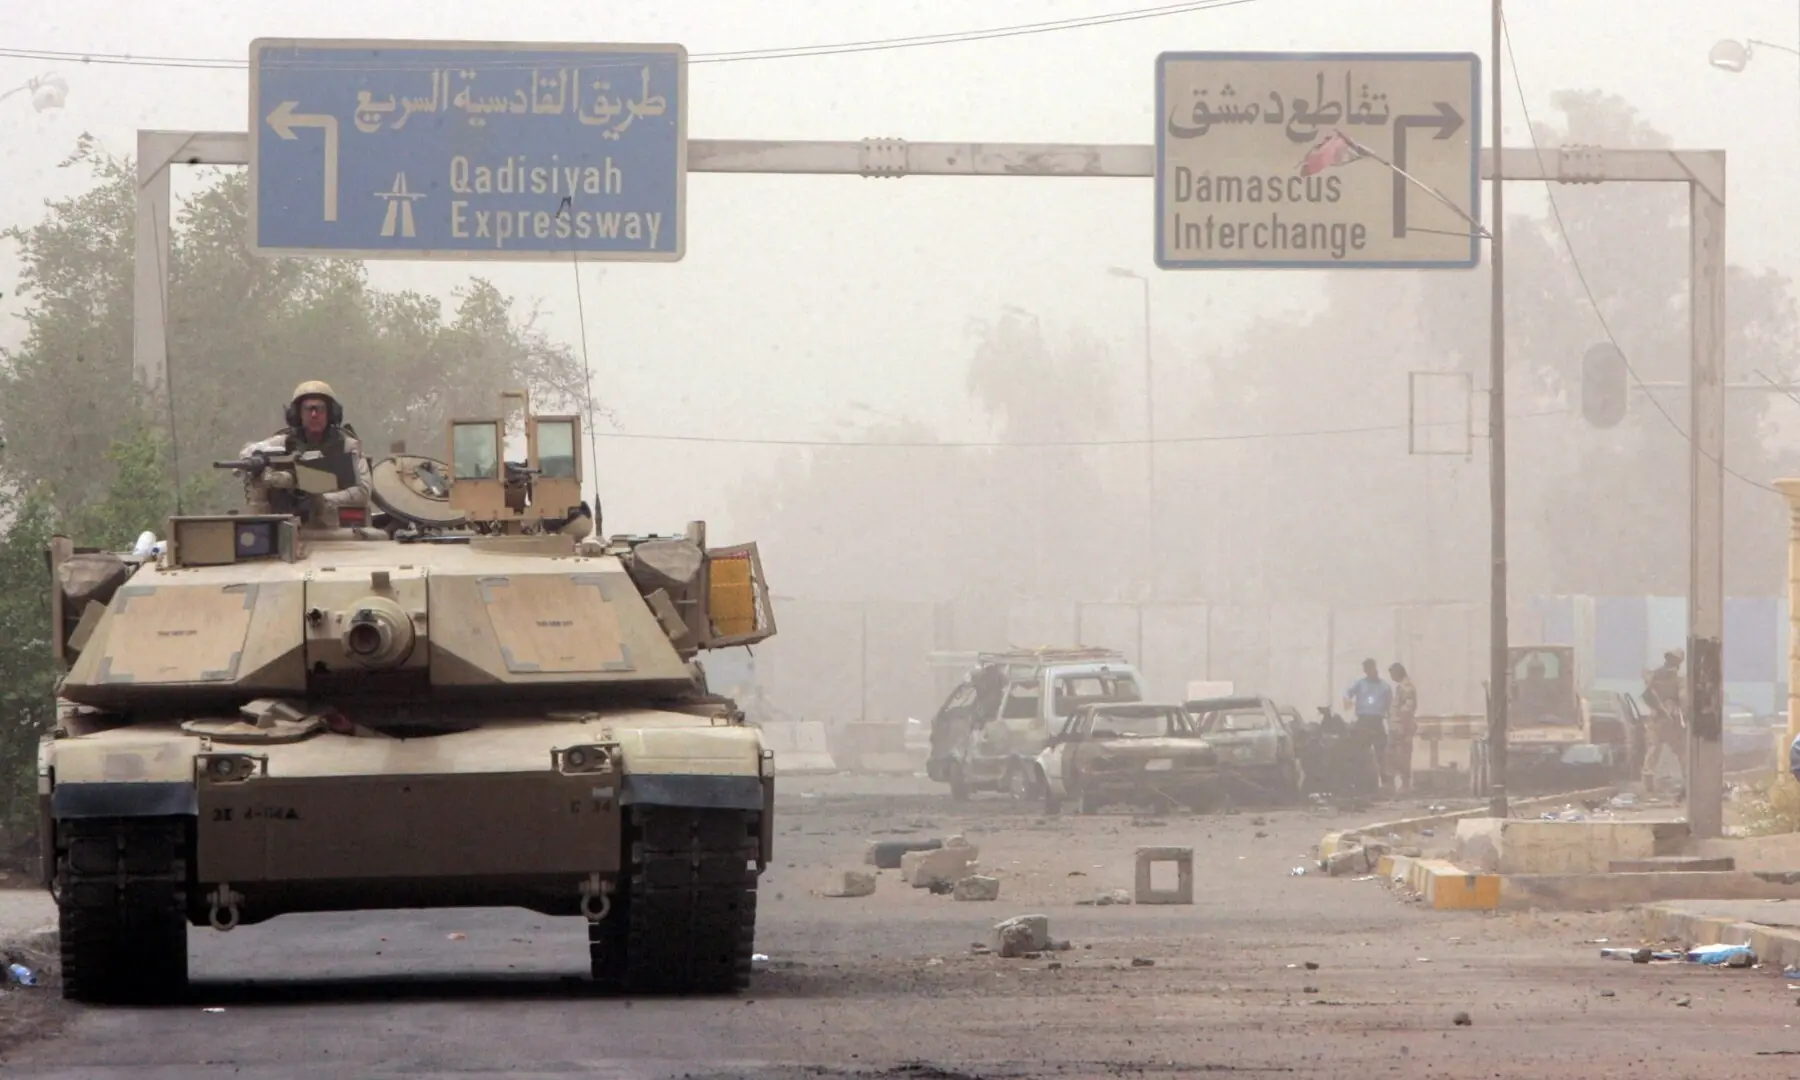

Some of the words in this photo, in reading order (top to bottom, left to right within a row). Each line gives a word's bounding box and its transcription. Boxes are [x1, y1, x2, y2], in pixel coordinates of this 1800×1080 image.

[353, 69, 448, 133] السريع
[453, 68, 578, 127] القادسية
[579, 66, 666, 141] طريق
[1168, 84, 1284, 140] دمشق
[1285, 69, 1390, 142] تقاطع
[449, 155, 622, 198] Qadisiyah
[1176, 166, 1342, 203] Damascus
[451, 201, 662, 249] Expressway
[1175, 213, 1366, 259] Interchange
